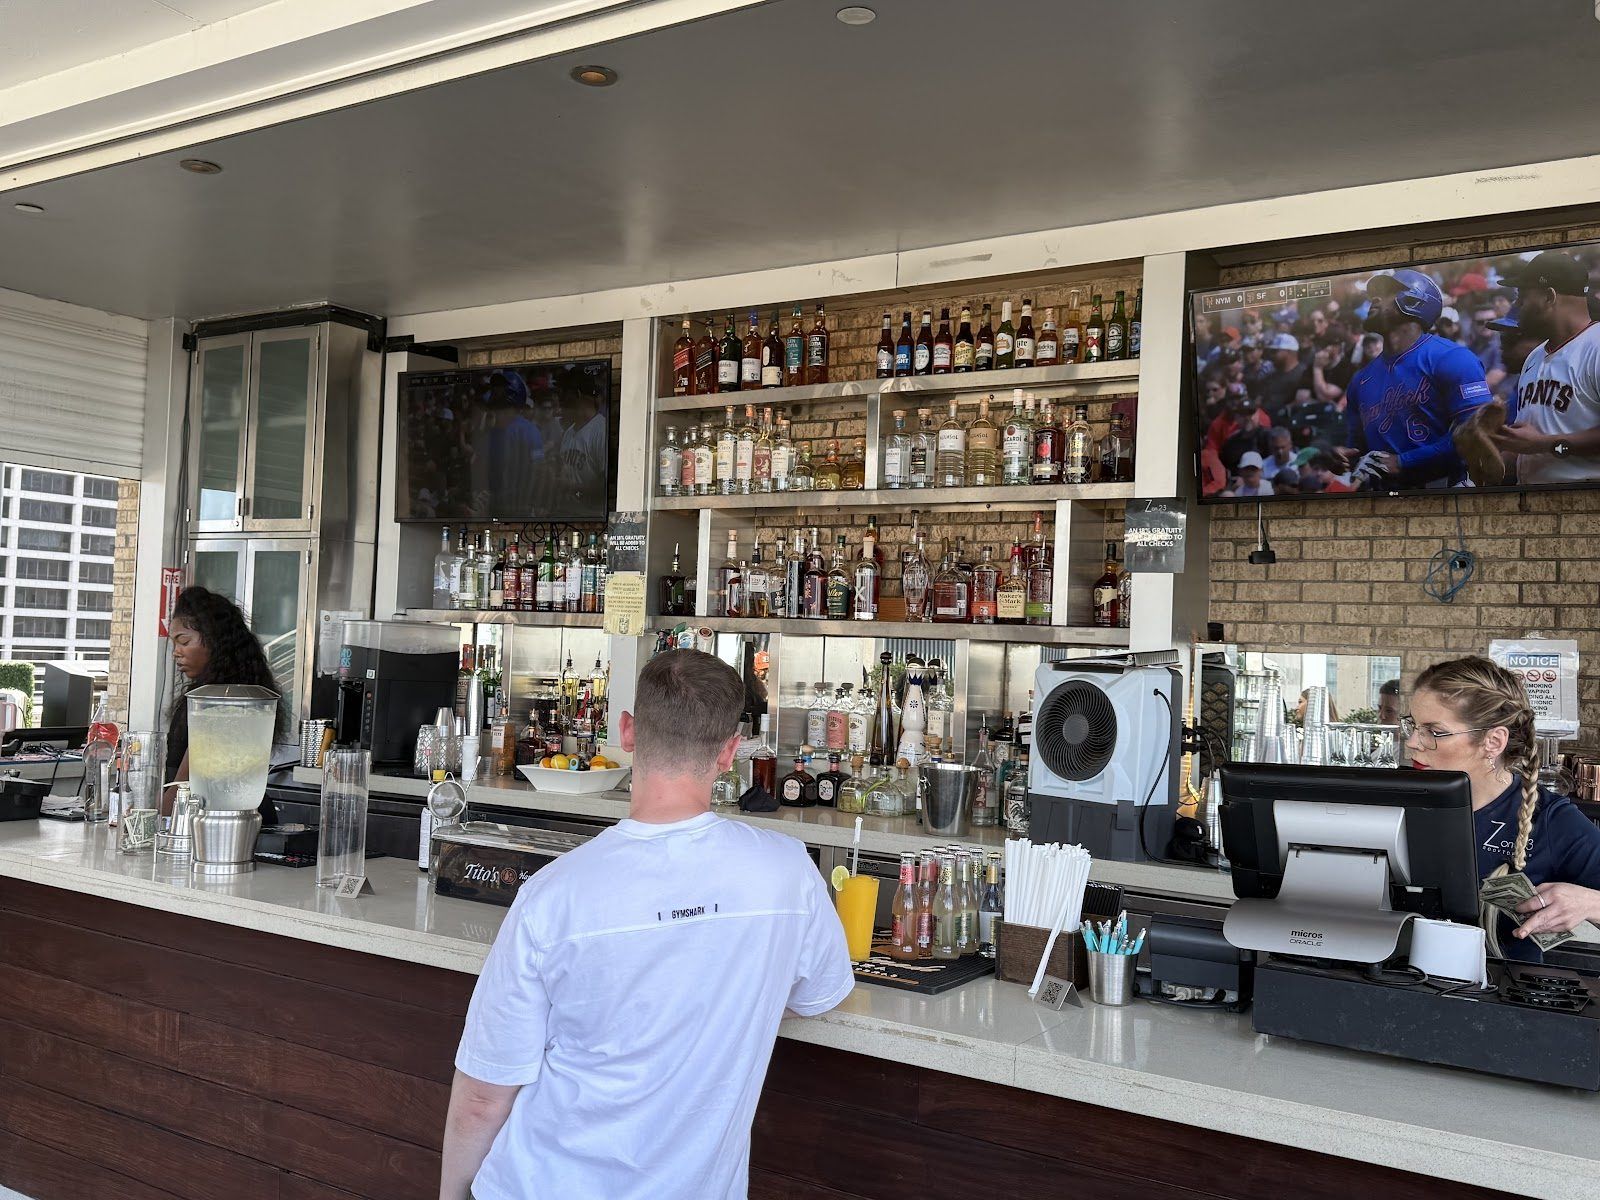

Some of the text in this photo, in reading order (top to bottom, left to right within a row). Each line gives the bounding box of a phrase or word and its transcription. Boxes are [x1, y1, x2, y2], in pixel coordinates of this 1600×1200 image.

[1215, 297, 1231, 305] NYM
[1237, 295, 1243, 303] 0
[1256, 292, 1267, 300] SF
[1279, 289, 1285, 297] 0
[1406, 414, 1430, 442] 6
[165, 574, 179, 584] FIRE
[1509, 656, 1559, 666] NOTICE
[463, 862, 500, 882] Tito's
[671, 905, 706, 919] GYMSHARK
[1291, 929, 1323, 939] micros
[1289, 938, 1324, 947] ORACLE
